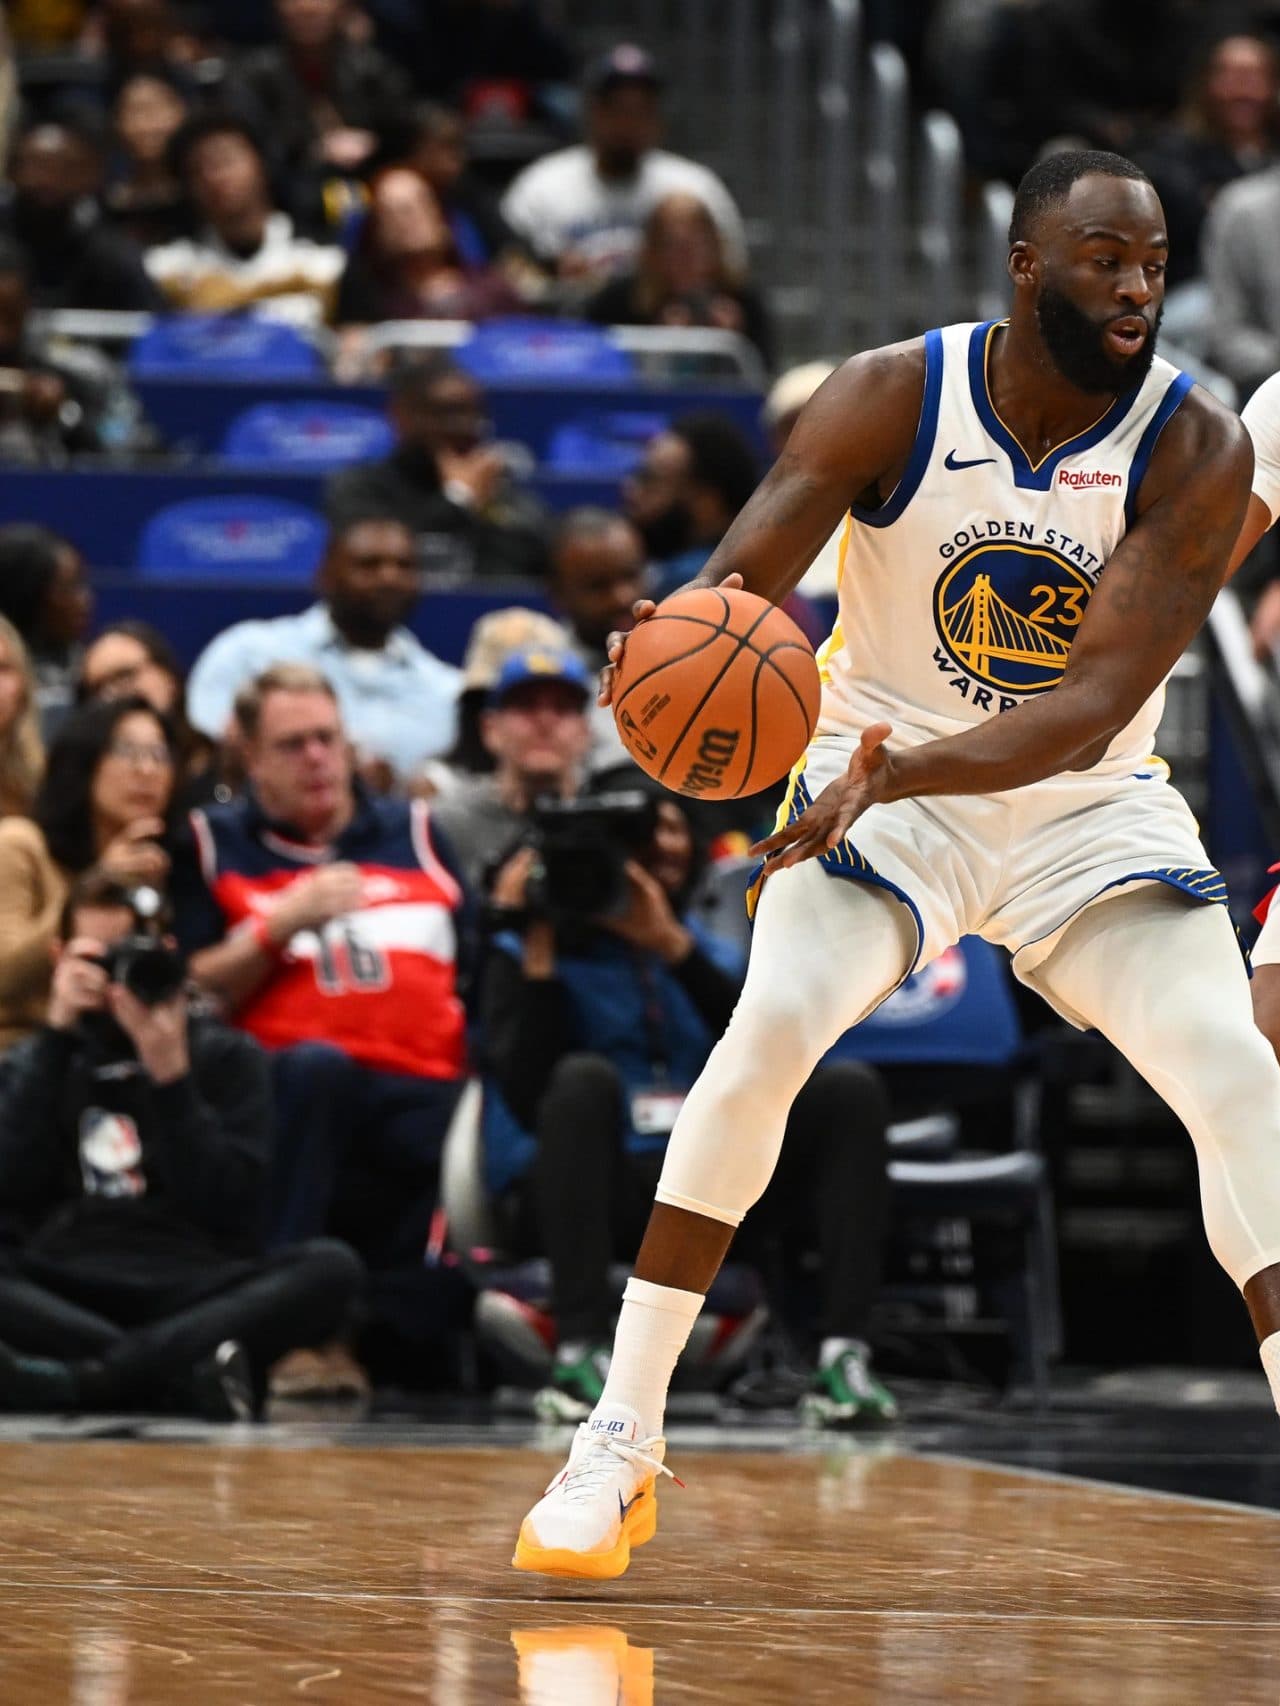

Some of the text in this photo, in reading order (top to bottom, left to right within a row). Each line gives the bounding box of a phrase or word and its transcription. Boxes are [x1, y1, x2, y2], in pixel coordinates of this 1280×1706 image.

[1059, 470, 1122, 490] Rakuten
[938, 520, 1035, 559] GOLDEN
[1029, 584, 1085, 626] 23
[932, 646, 1032, 715] WARR
[678, 727, 741, 797] Wils
